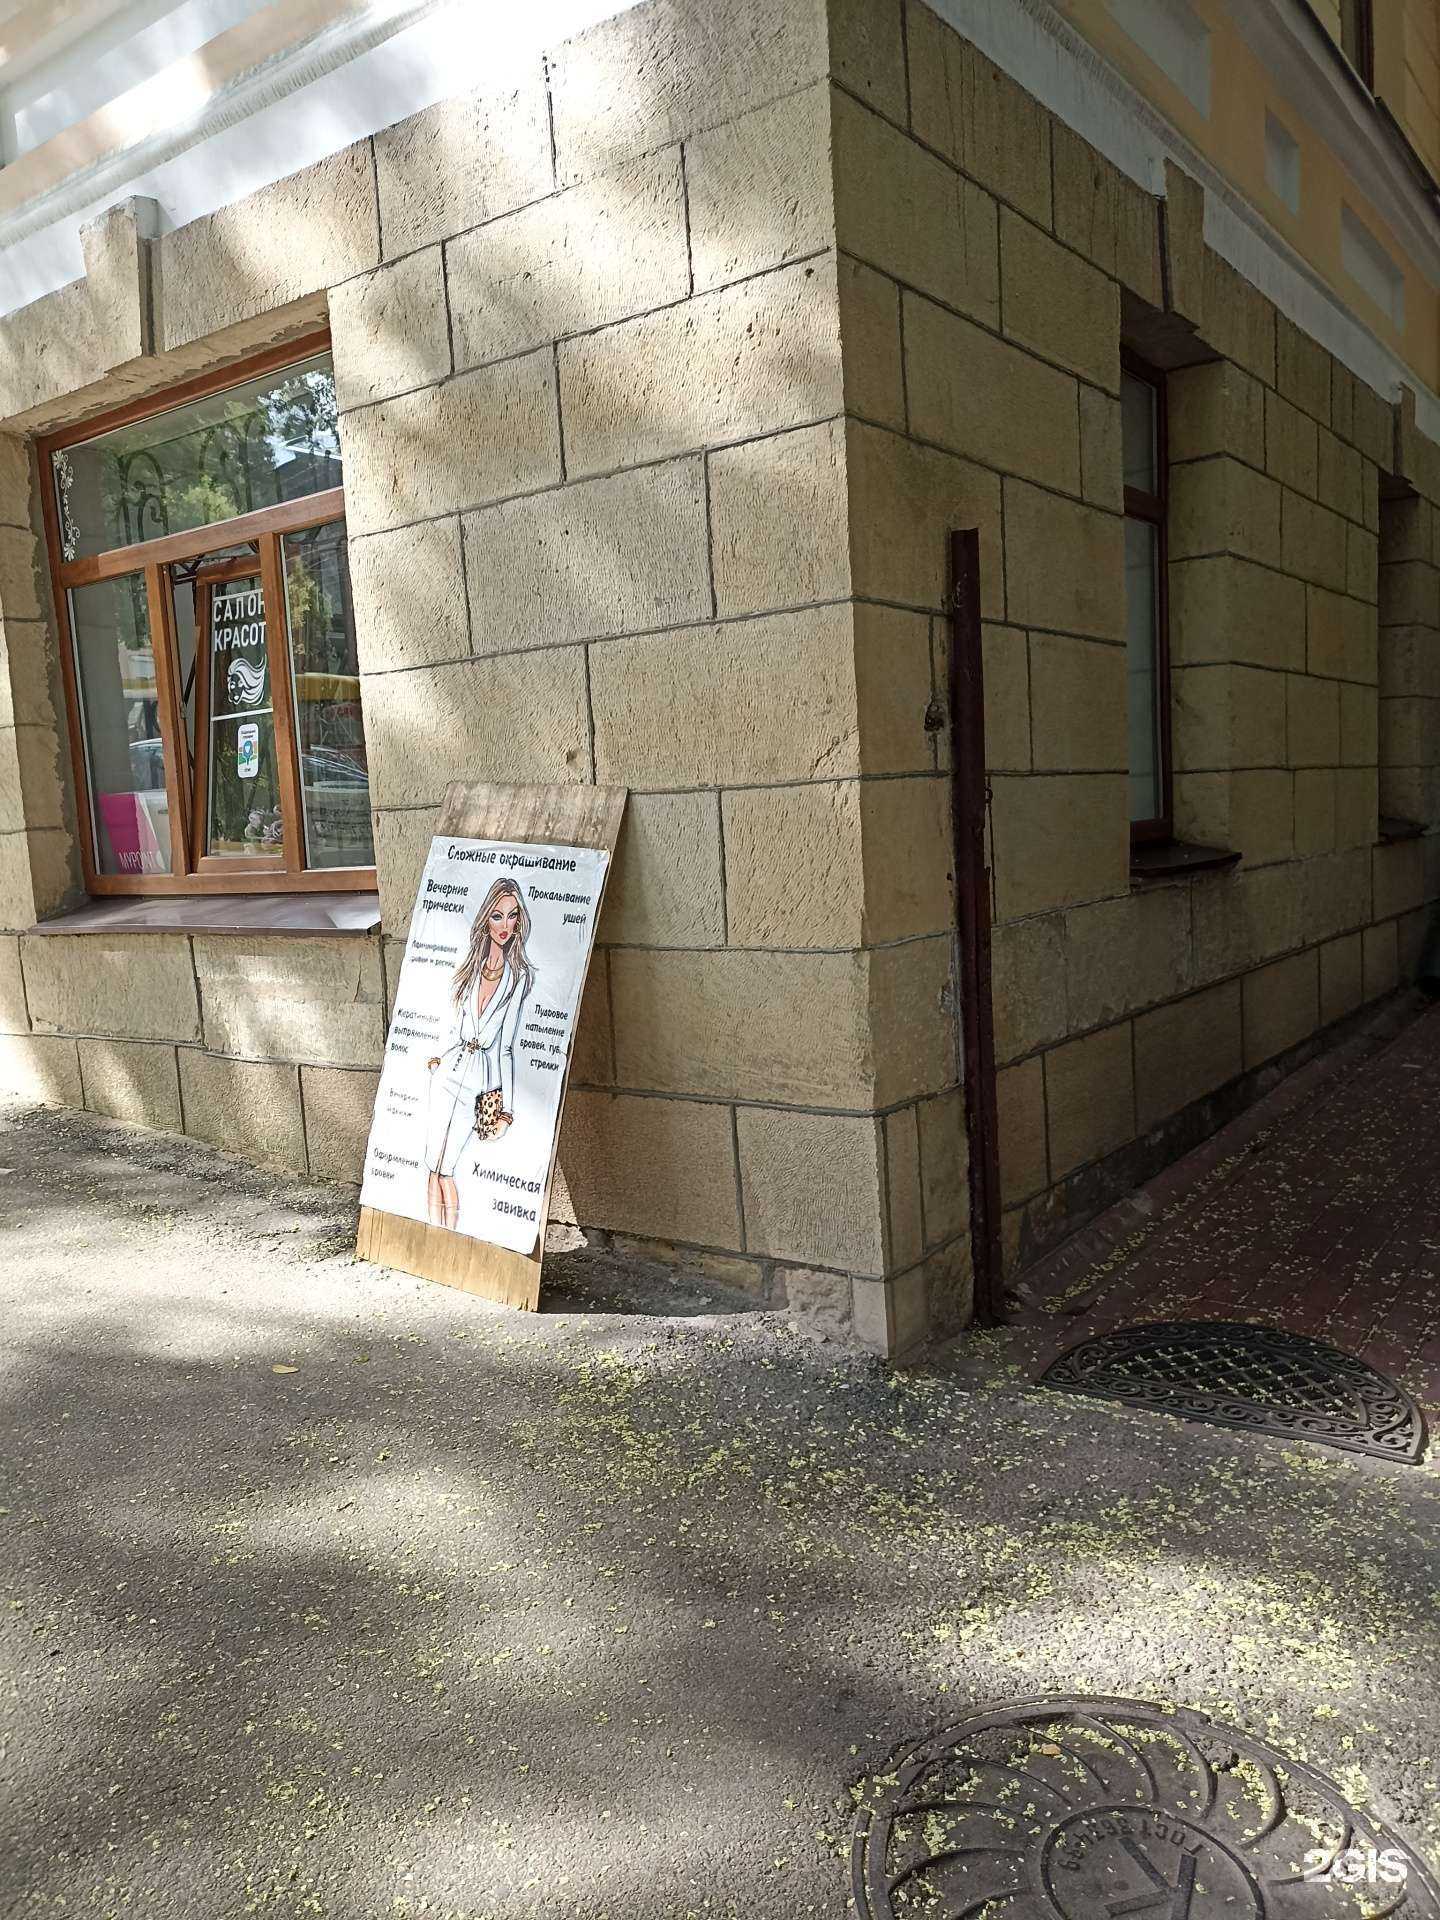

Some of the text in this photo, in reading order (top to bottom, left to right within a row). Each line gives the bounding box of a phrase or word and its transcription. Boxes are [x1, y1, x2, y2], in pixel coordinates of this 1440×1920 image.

[447, 845, 577, 872] Сложные окрашивание
[426, 879, 469, 897] Вечерние
[527, 886, 591, 906] Прокалывание
[422, 898, 465, 914] прически
[562, 912, 587, 925] ушей
[534, 1004, 569, 1020] Пудровое
[525, 1023, 566, 1037] напыление
[530, 1058, 560, 1071] стрелки
[472, 1162, 541, 1195] Химическая
[492, 1198, 537, 1222] завивка
